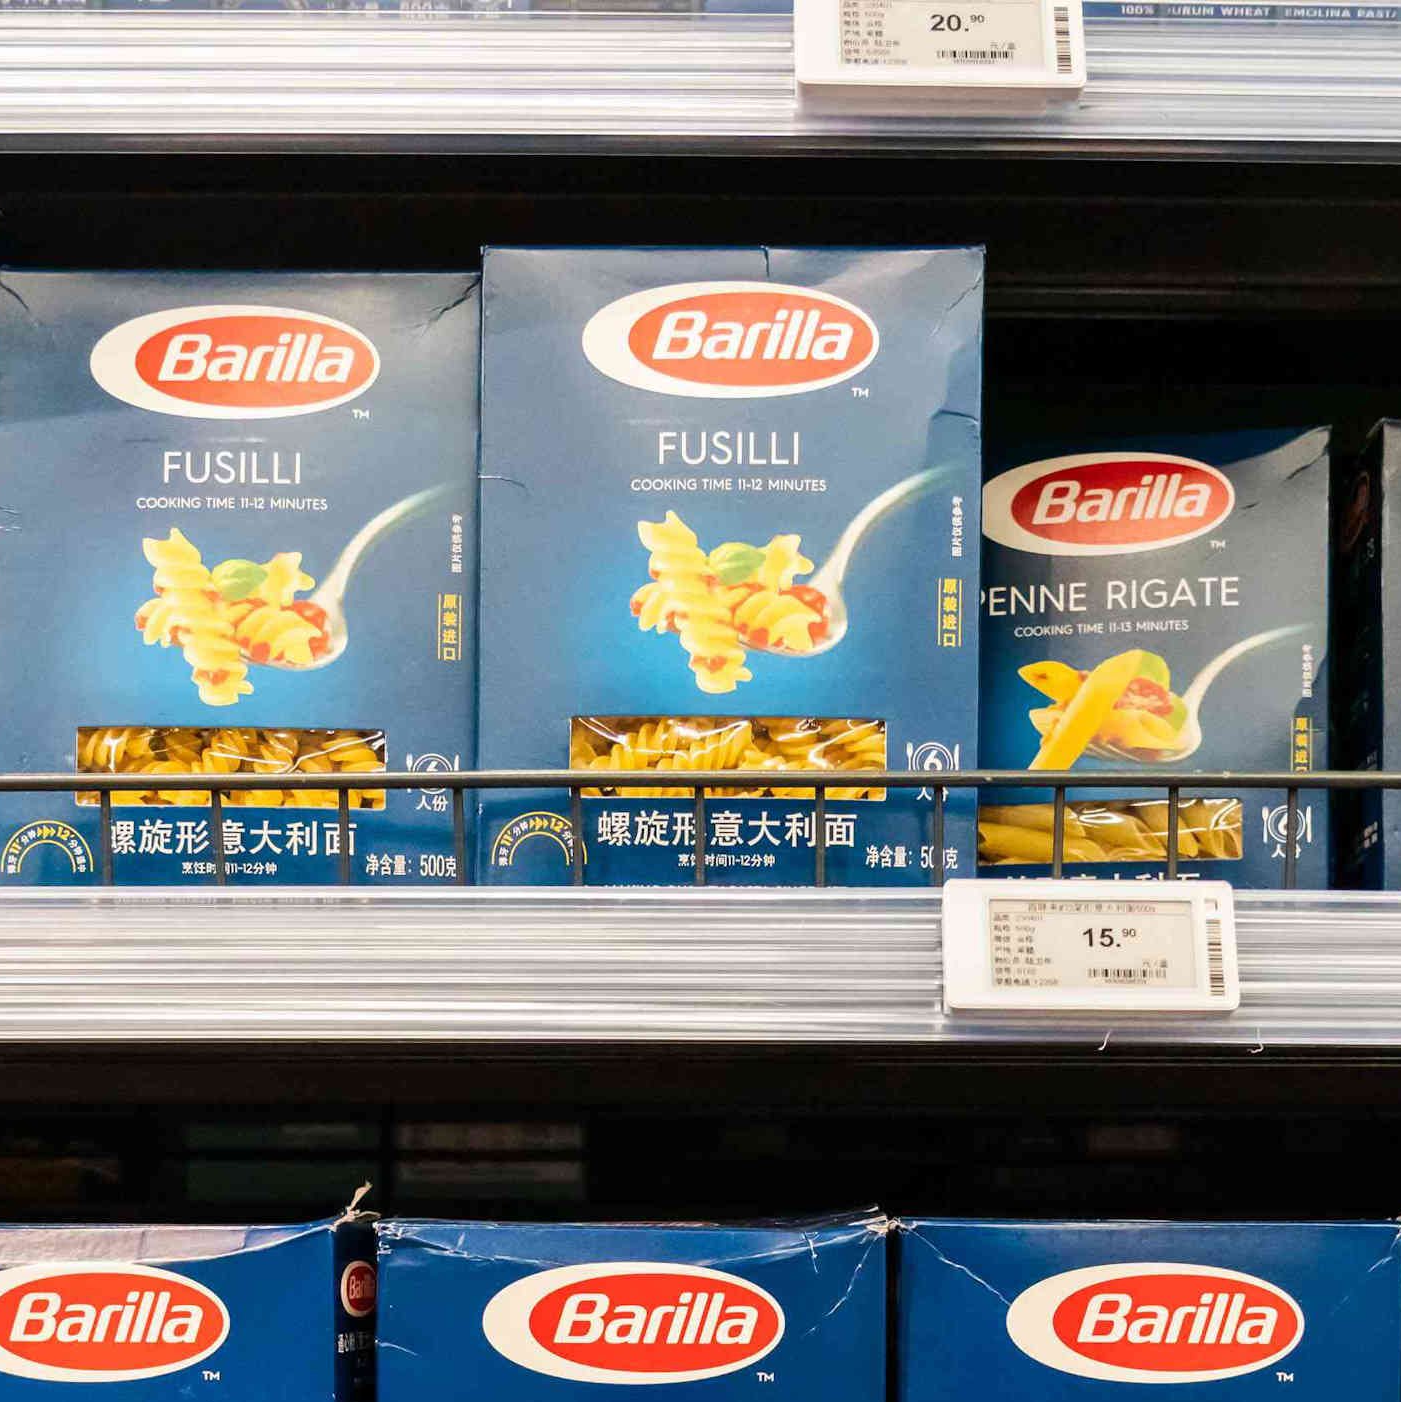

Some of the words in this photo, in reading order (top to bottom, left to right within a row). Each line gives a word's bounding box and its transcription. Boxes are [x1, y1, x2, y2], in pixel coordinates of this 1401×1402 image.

[652, 309, 854, 361] Barilla
[158, 333, 355, 383] Barilla
[164, 451, 300, 484] FUSILLI
[659, 431, 798, 464] FUSILLI
[137, 497, 201, 508] COOKING
[206, 496, 235, 508] TIME
[241, 496, 264, 509] 11-12
[271, 498, 327, 510] MINUTES
[1032, 475, 1210, 526] Barilla
[981, 583, 1087, 616] ENNE
[1107, 577, 1239, 609] RIGATE
[1014, 624, 1072, 638] COOKING
[1077, 623, 1104, 634] TIME
[1109, 621, 1131, 632] 11-13
[1136, 620, 1189, 631] MINUTES
[597, 812, 857, 847] 螺旋形意大利面
[9, 1291, 203, 1344] Barilla
[554, 1292, 758, 1345] Barilla
[1077, 1292, 1278, 1345] Barilla
